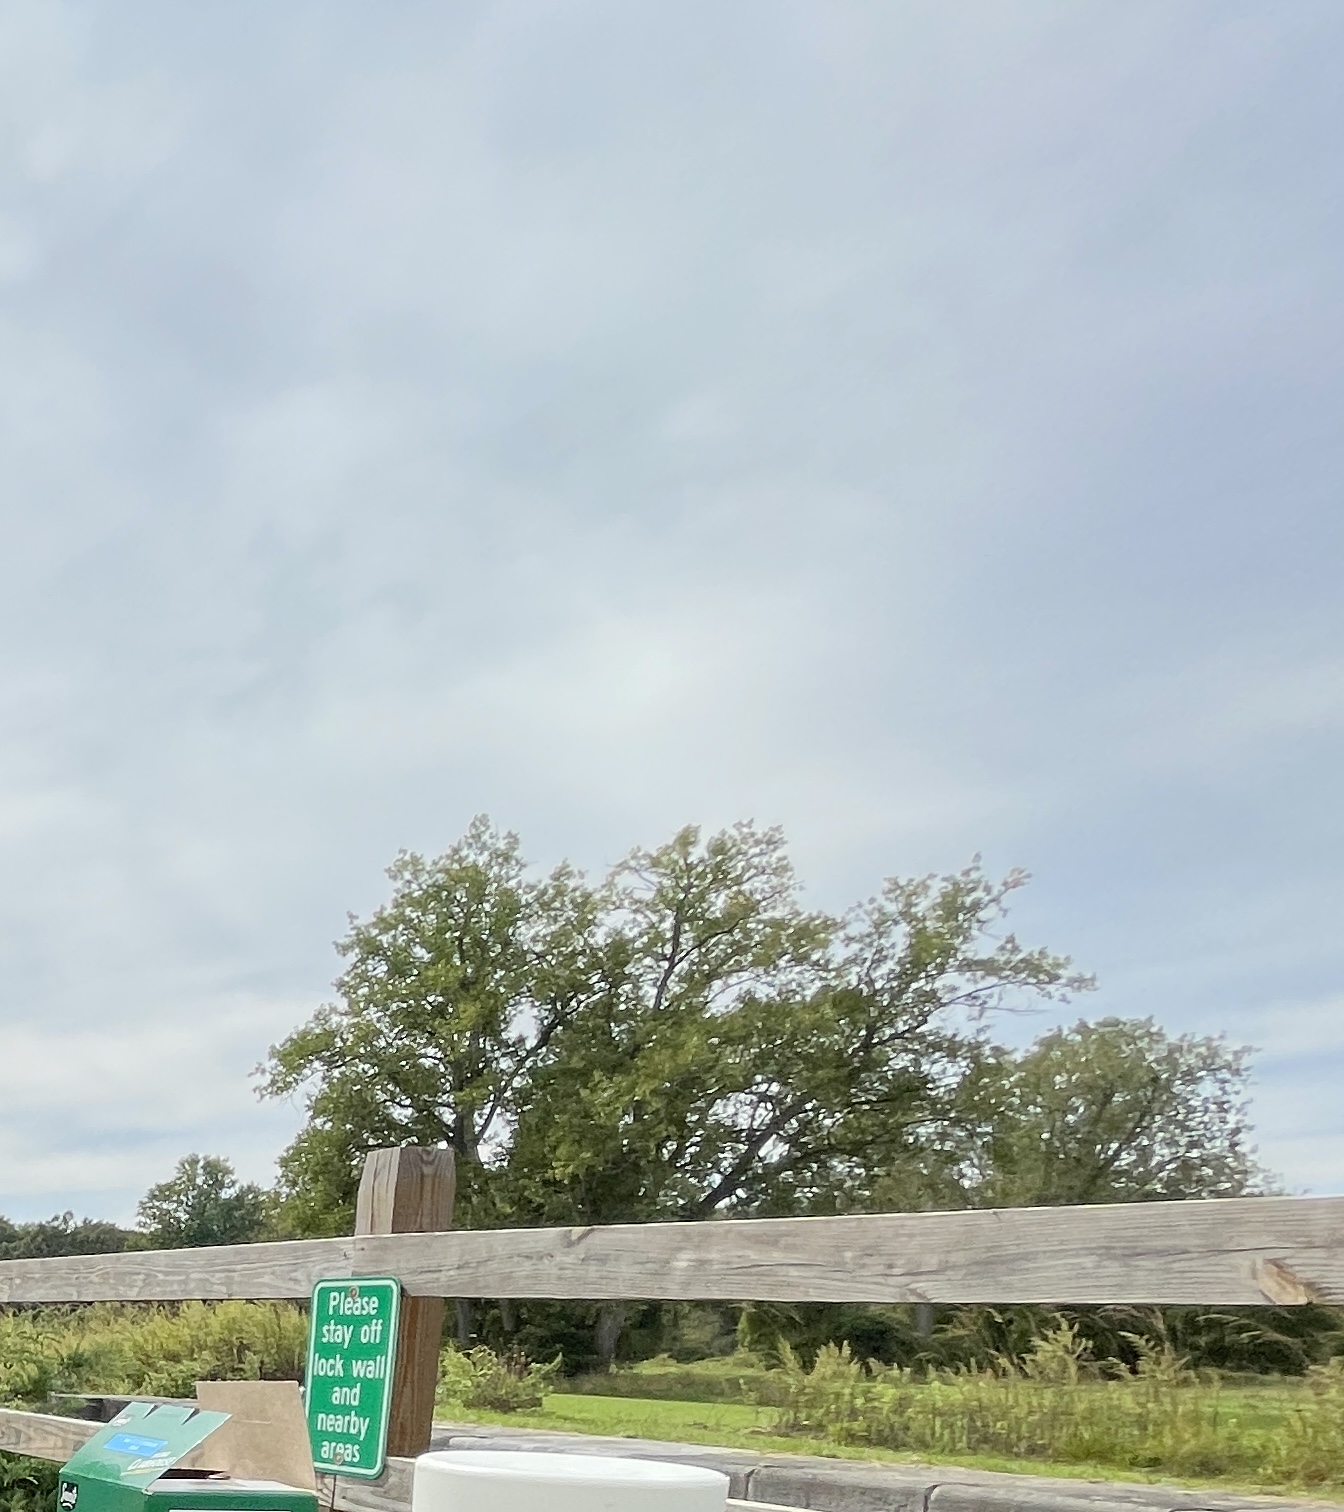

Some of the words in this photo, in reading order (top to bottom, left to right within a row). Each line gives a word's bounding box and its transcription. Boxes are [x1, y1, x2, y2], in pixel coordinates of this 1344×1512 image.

[328, 1291, 379, 1316] Please
[321, 1321, 353, 1349] stay
[360, 1319, 383, 1344] off
[313, 1353, 344, 1377] lock
[352, 1354, 386, 1379] wall
[331, 1383, 361, 1406] and
[317, 1412, 370, 1441] nearby
[321, 1440, 360, 1463] areas
